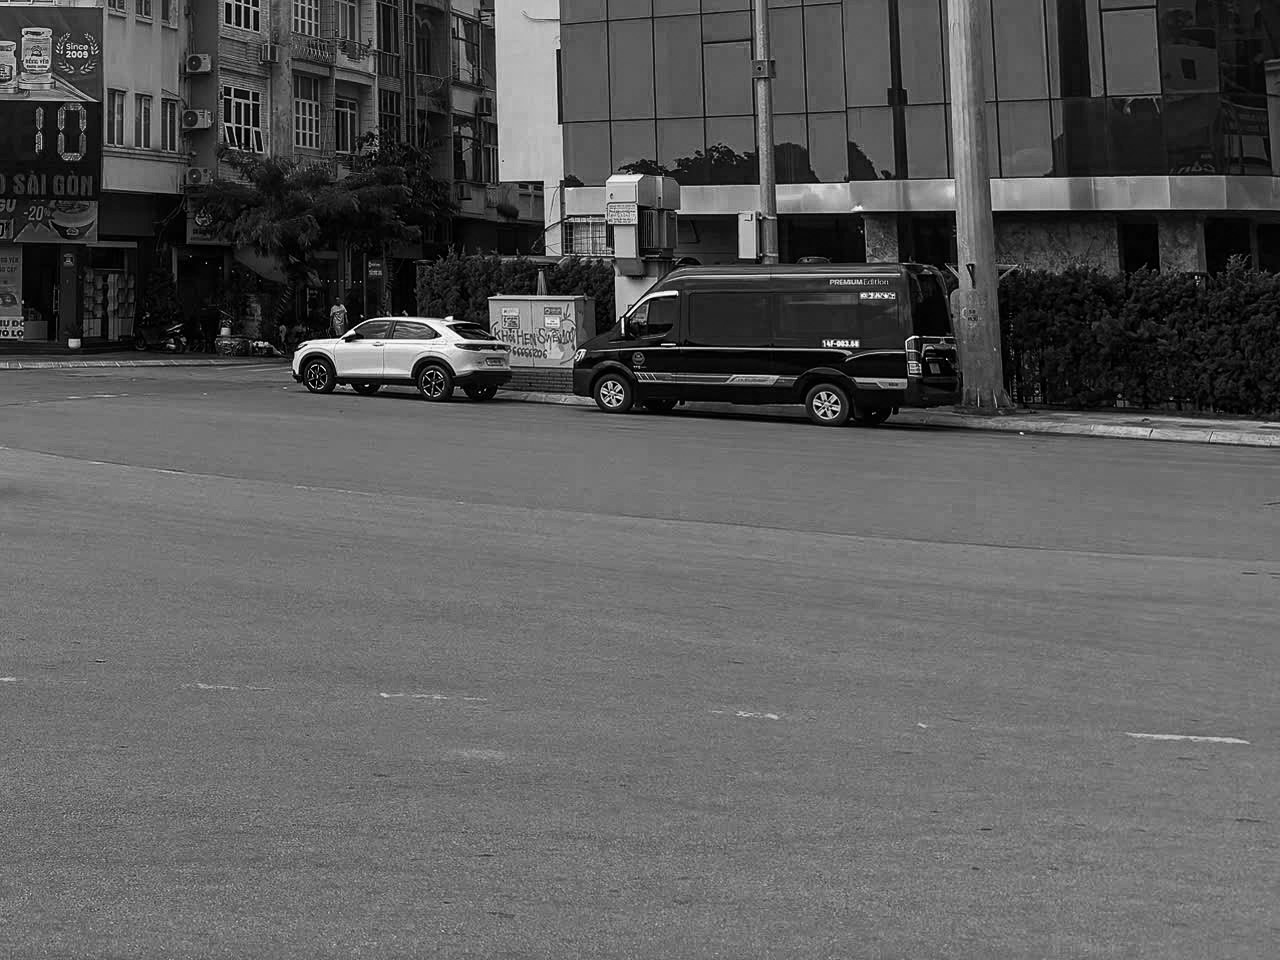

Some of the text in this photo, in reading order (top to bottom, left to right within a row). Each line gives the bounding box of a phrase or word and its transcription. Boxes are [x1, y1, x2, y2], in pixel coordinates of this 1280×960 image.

[66, 43, 89, 51] Since
[66, 50, 89, 59] 2009
[863, 278, 889, 286] Edition
